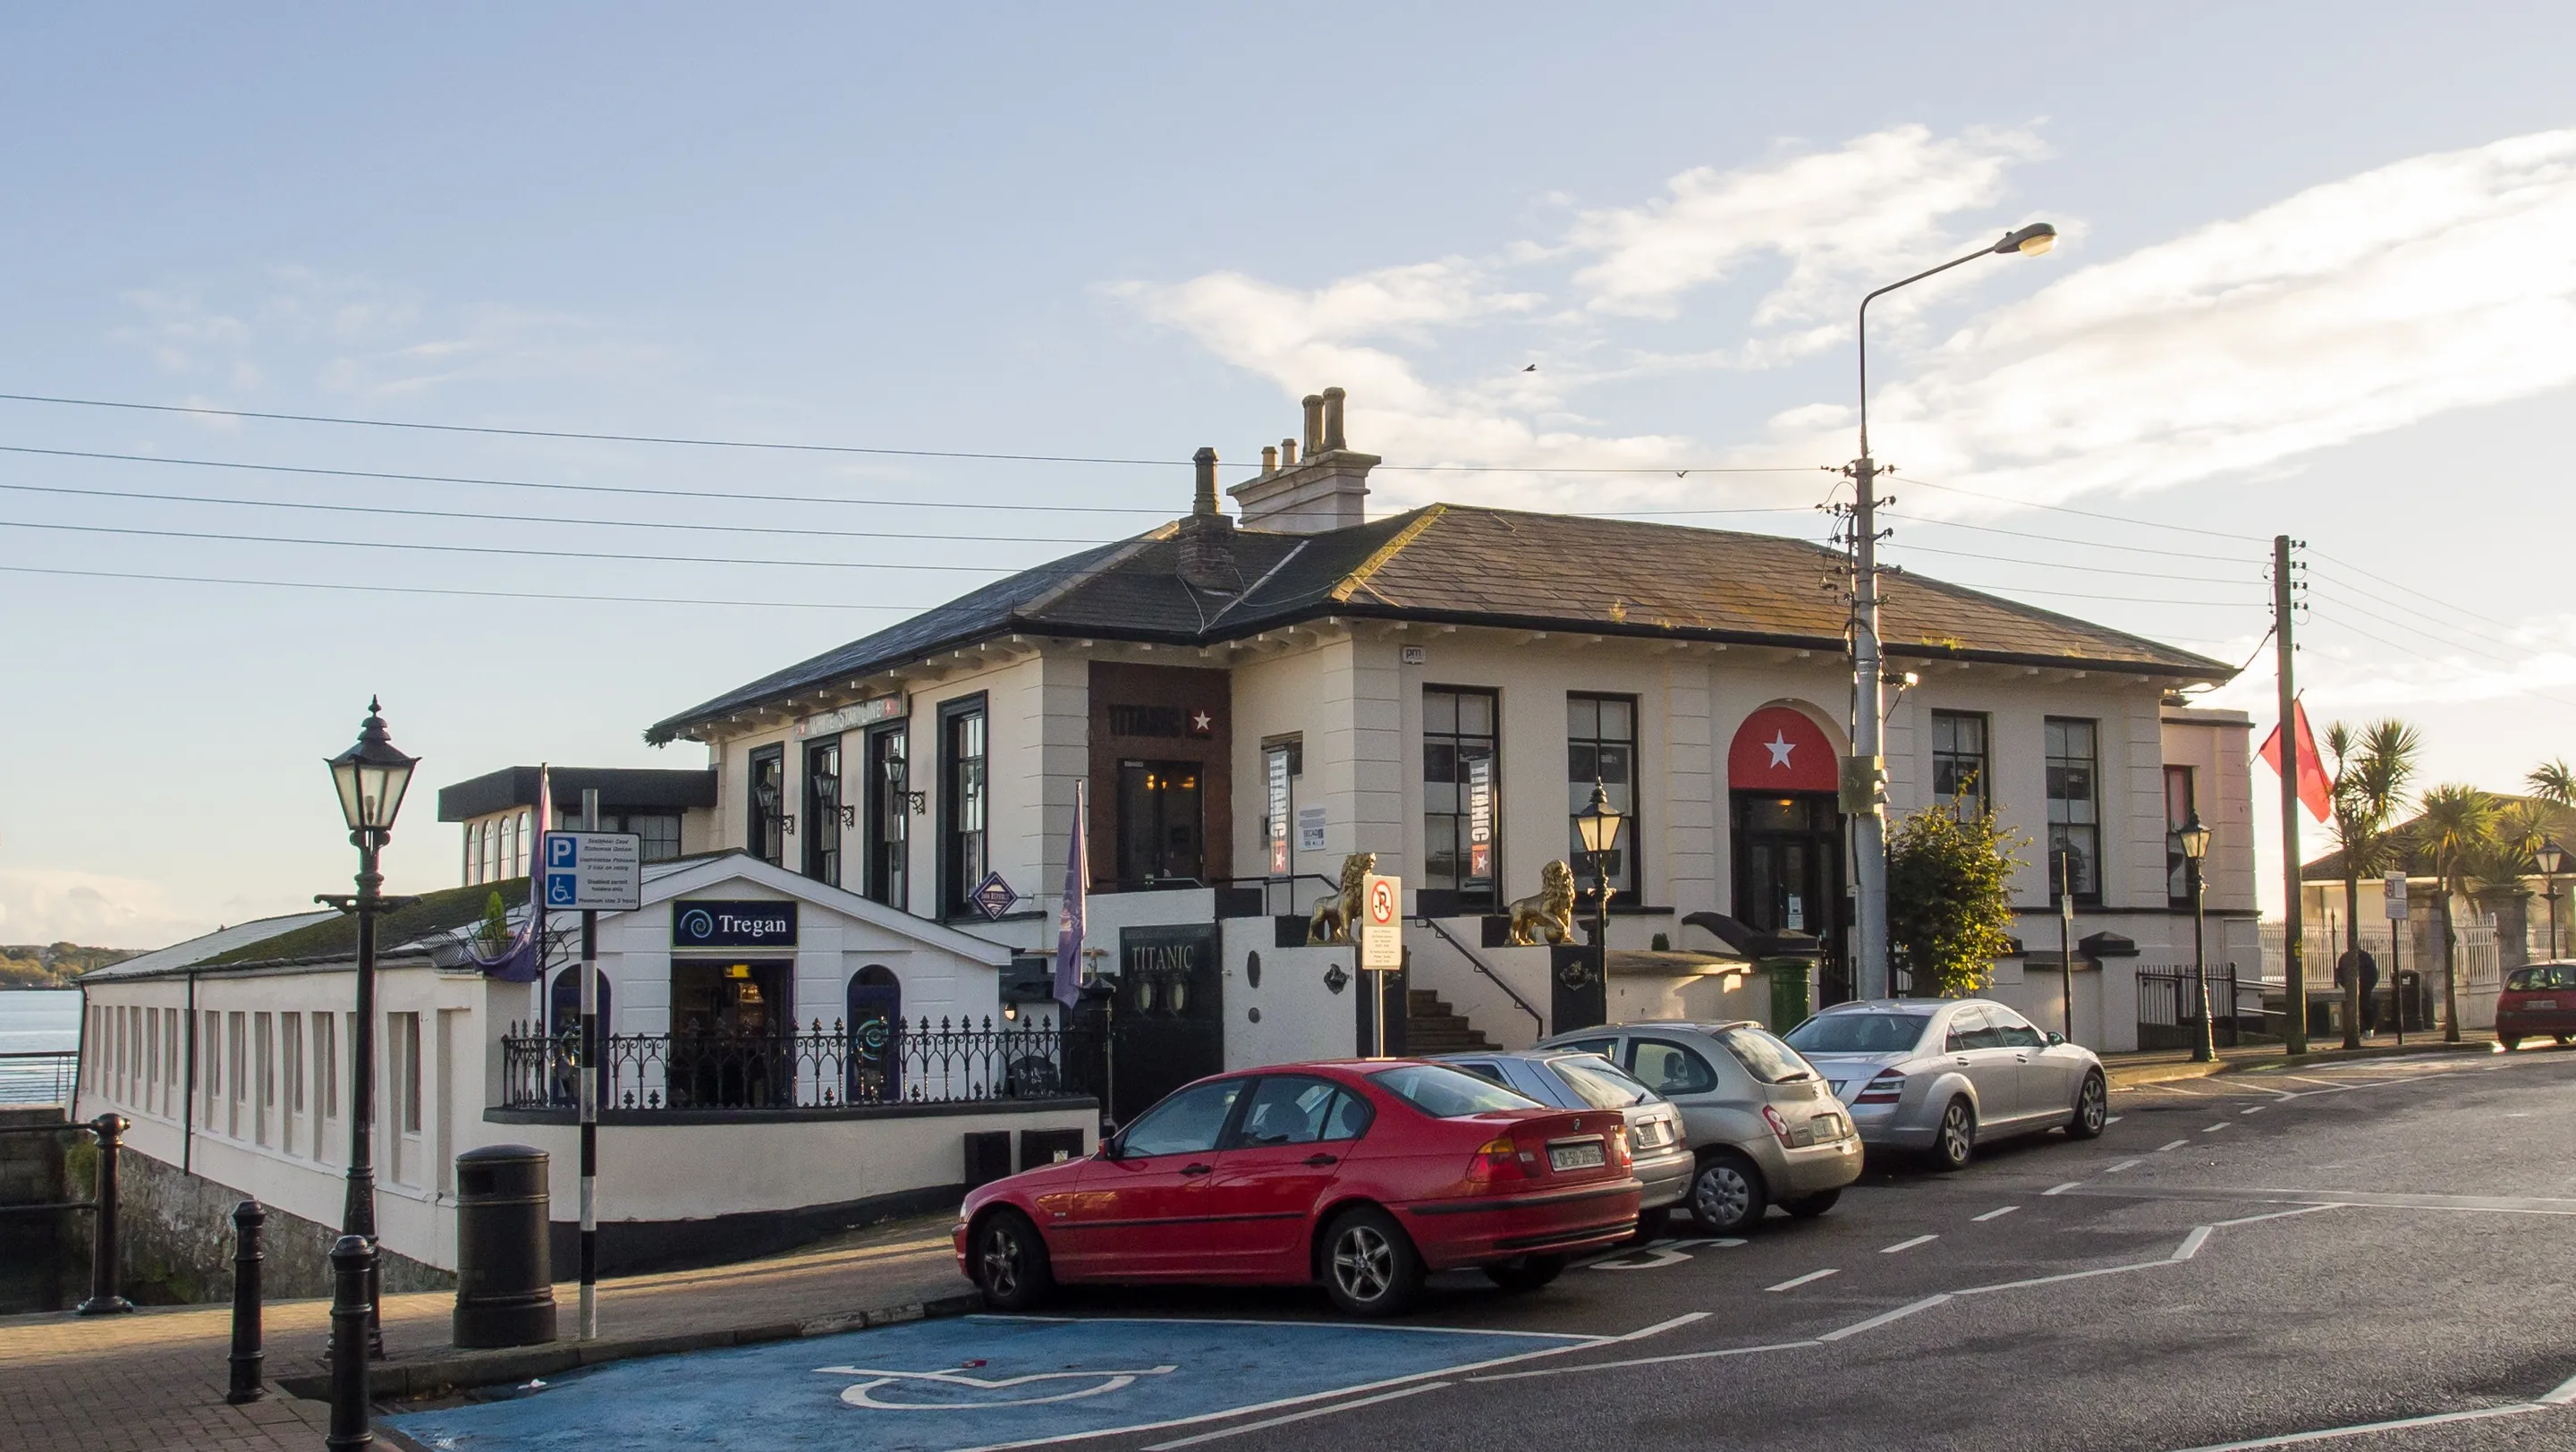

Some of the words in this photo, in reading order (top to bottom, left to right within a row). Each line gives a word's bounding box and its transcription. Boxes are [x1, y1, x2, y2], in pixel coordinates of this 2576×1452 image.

[809, 713, 835, 734] WHITE
[861, 700, 881, 724] LINE
[1471, 762, 1489, 842] TITANIC
[553, 839, 572, 865] P
[719, 914, 786, 937] Tregan
[1131, 945, 1194, 971] TITANIC
